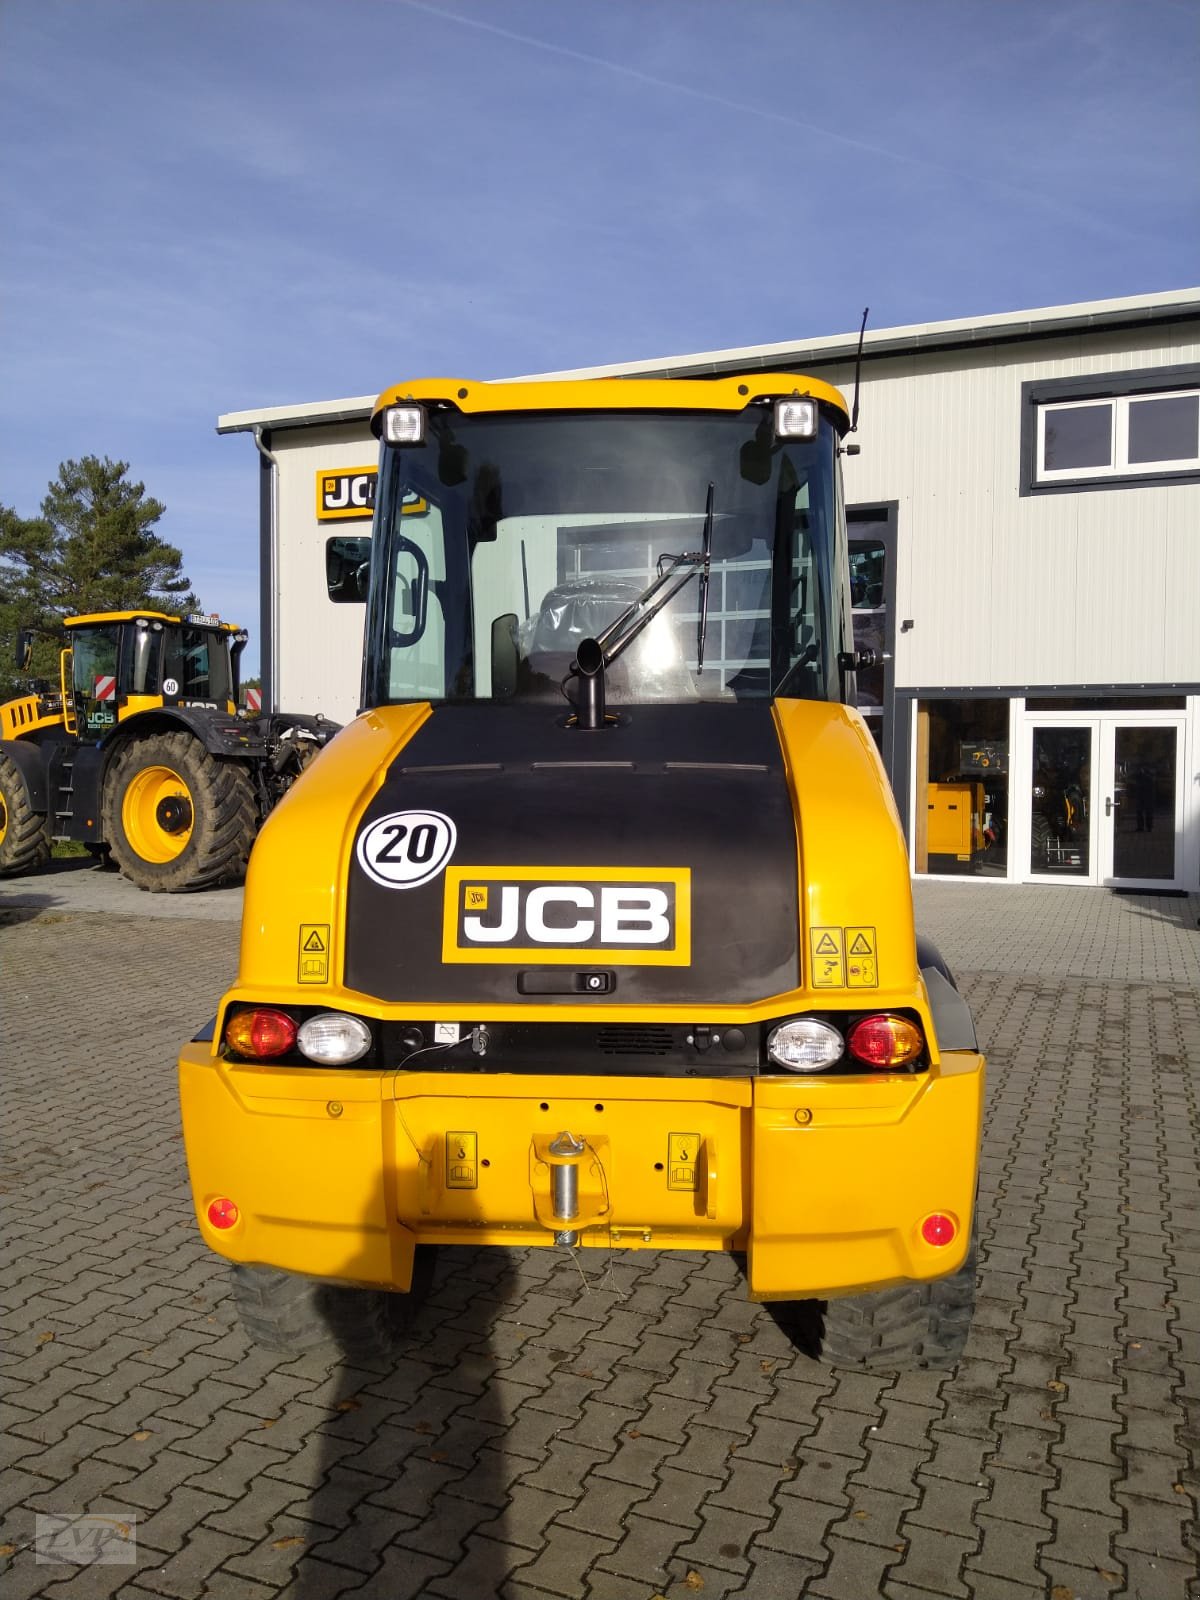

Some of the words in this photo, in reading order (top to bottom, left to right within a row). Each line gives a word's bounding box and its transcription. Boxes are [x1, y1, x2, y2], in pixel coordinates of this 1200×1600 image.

[166, 681, 176, 692] 60
[88, 712, 114, 724] JCB
[375, 823, 438, 864] 20
[463, 886, 670, 943] JCB
